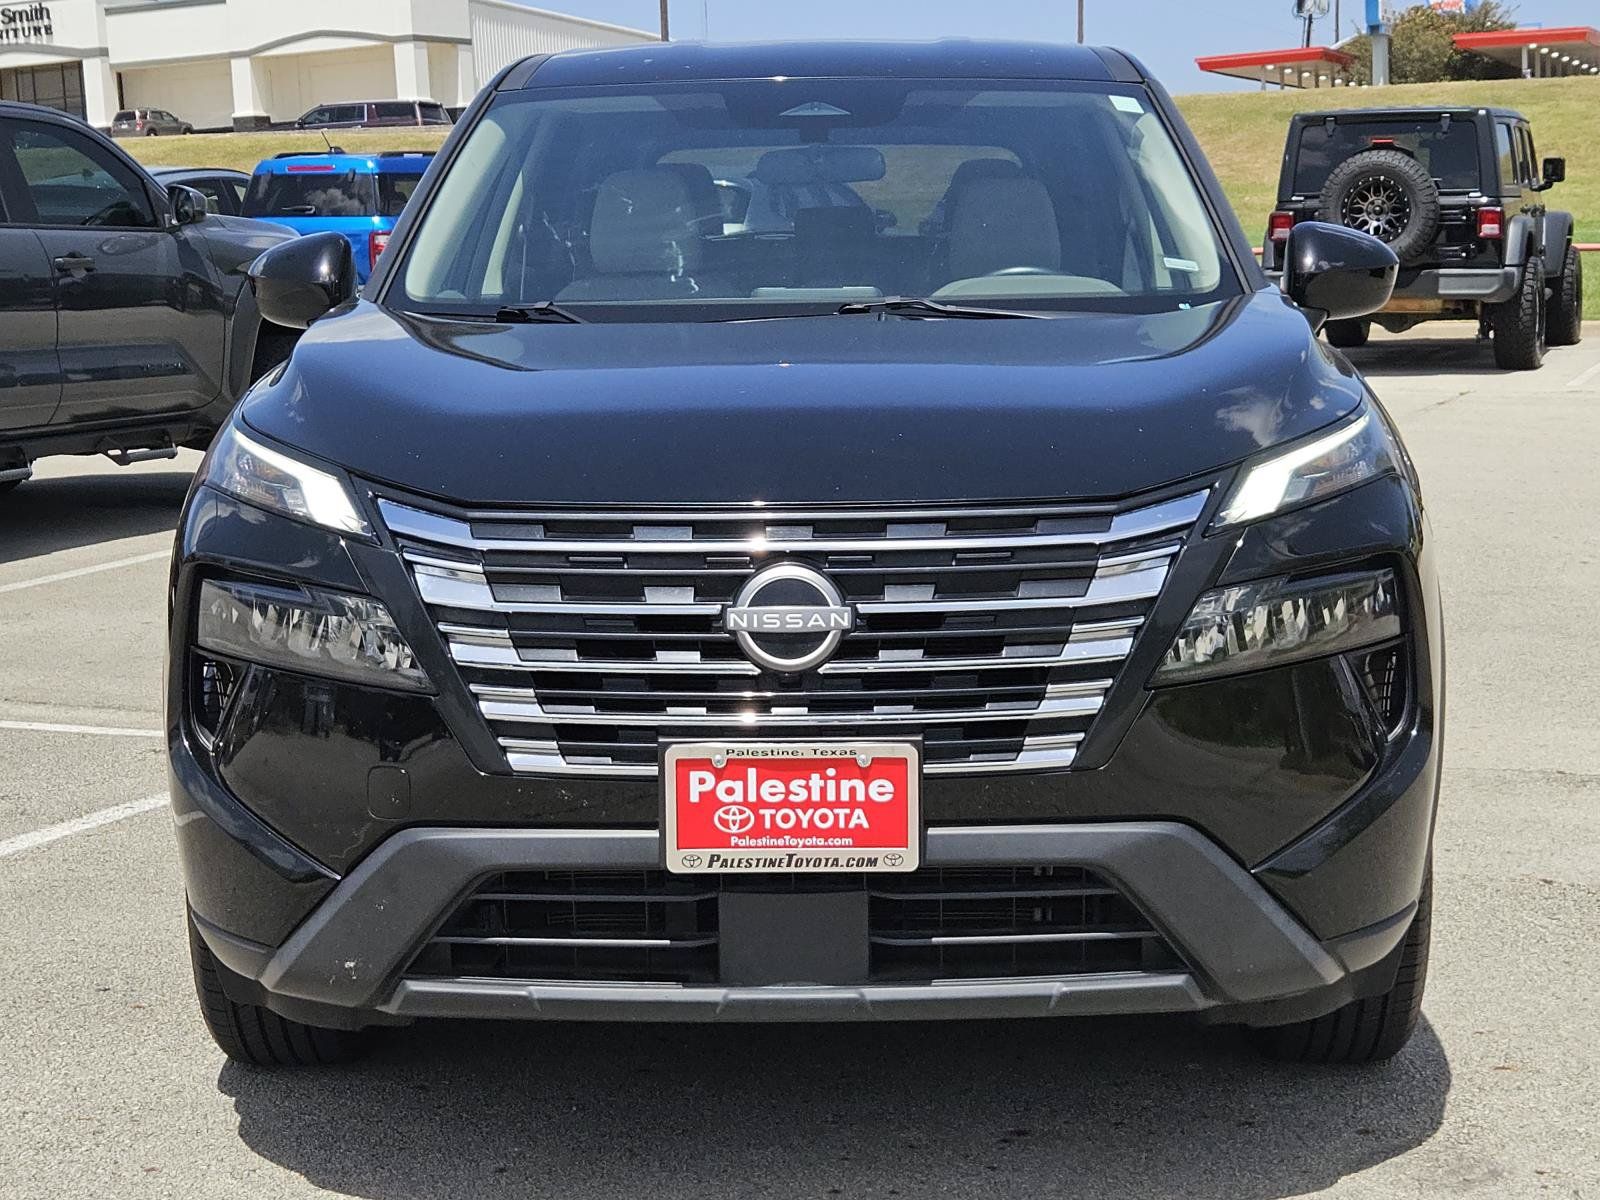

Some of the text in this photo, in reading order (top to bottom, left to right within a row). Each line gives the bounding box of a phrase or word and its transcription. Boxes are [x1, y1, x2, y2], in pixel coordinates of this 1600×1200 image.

[1, 2, 51, 25] Smith
[729, 612, 849, 628] NISSAN
[811, 748, 858, 756] Texas
[689, 768, 895, 803] Palestine
[759, 808, 870, 829] TOYOTA
[731, 836, 853, 848] PalestineToyota.com
